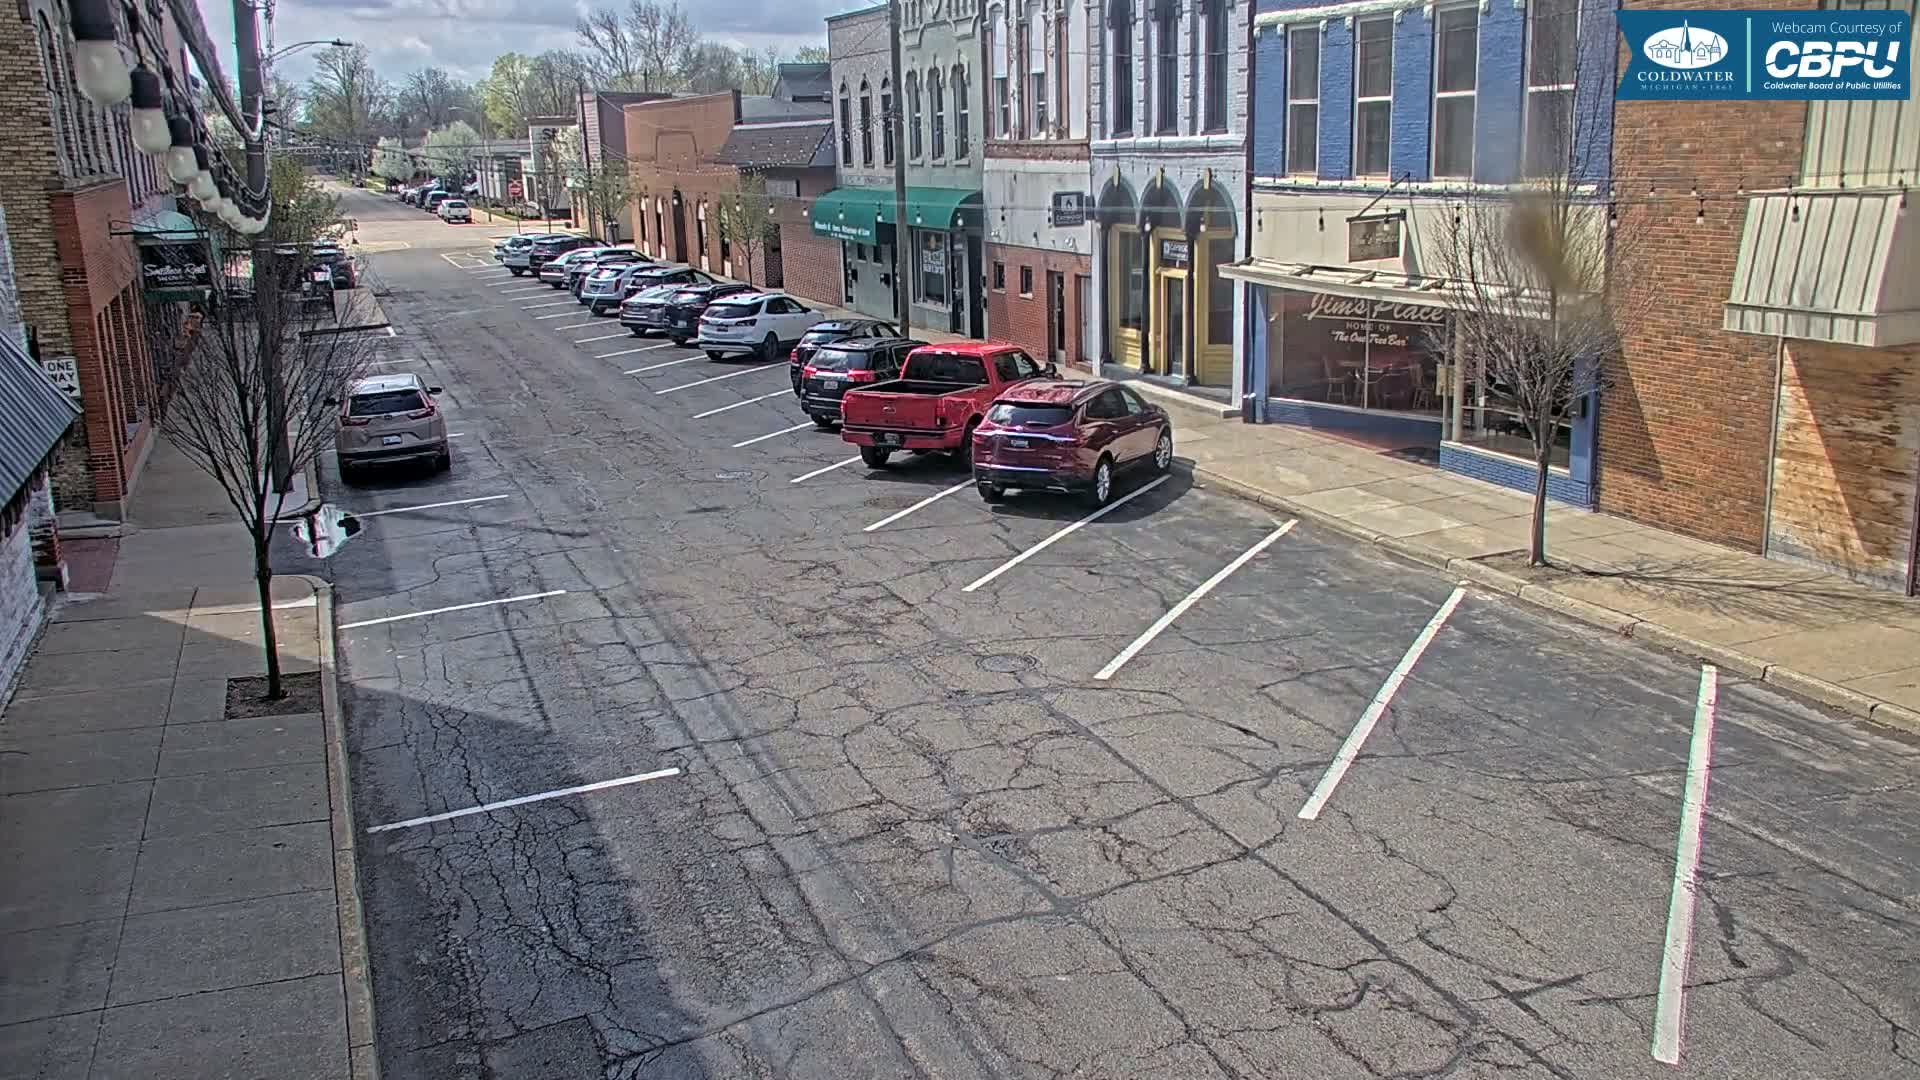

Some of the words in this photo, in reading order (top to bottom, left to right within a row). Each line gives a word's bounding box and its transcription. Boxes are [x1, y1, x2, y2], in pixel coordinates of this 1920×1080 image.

[1307, 292, 1368, 320] Jim's
[1371, 301, 1444, 320] Place
[1345, 321, 1373, 331] HOME
[1379, 323, 1391, 333] OF
[47, 361, 74, 371] ONE
[48, 372, 75, 382] WAY
